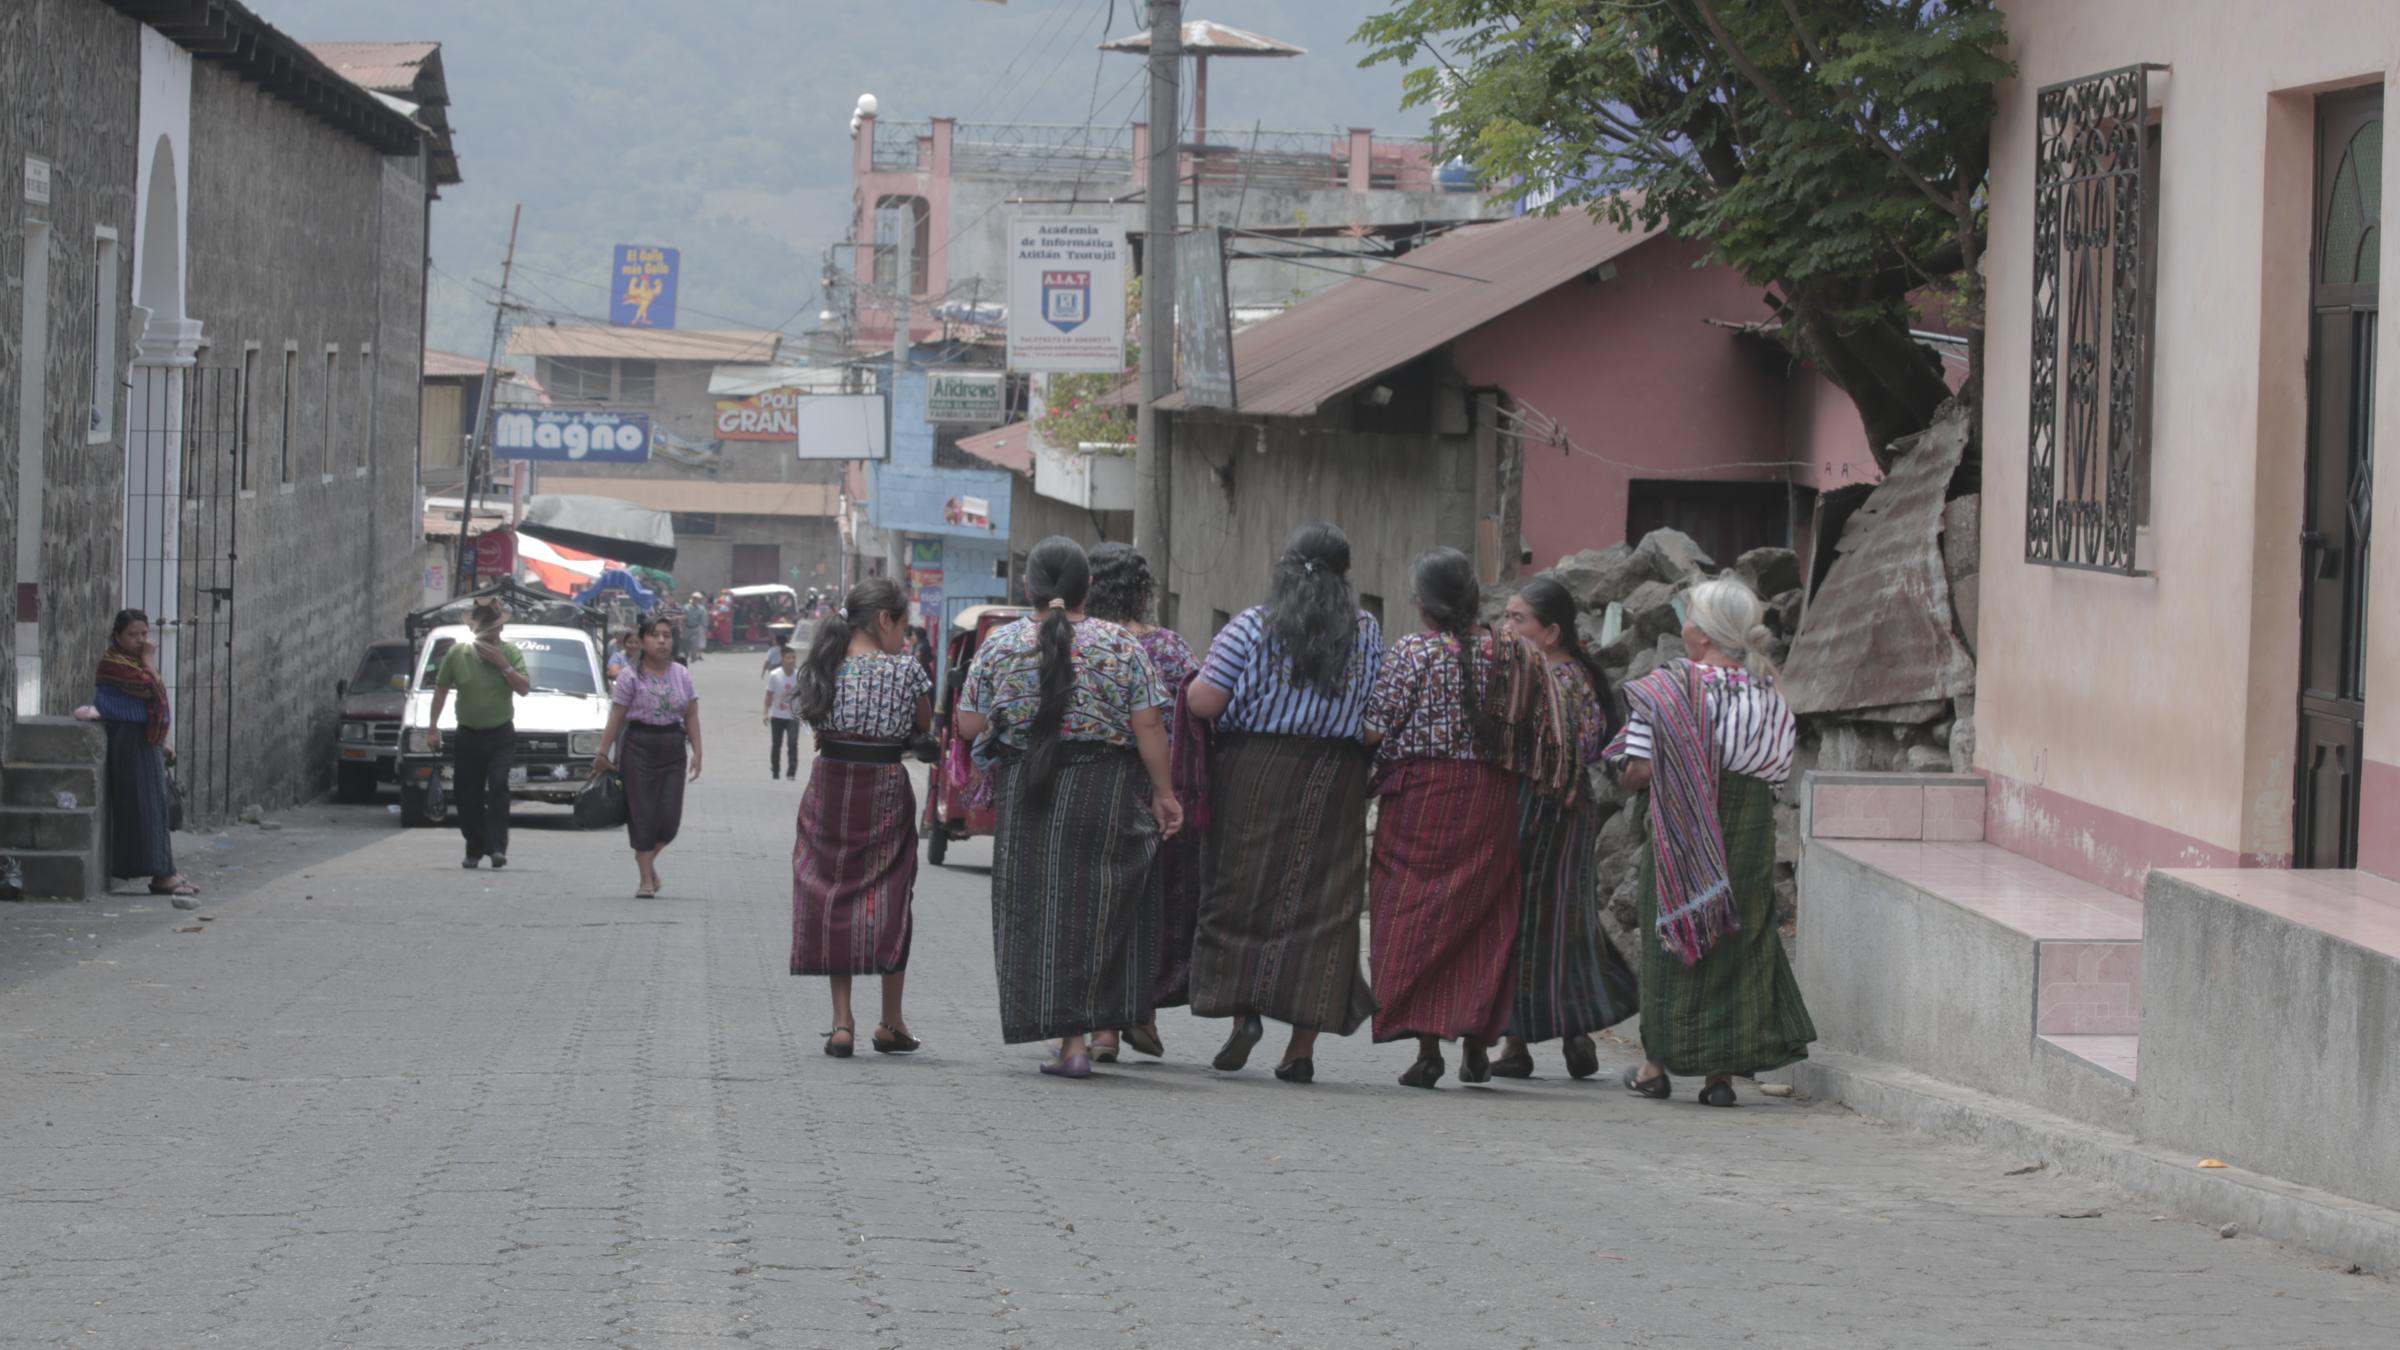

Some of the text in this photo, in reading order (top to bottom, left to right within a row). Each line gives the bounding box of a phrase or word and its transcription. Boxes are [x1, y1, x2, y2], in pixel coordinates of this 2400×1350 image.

[1038, 225, 1099, 235] Academia
[1021, 237, 1114, 248] de Informática
[1044, 274, 1089, 285] A.I.A.T.
[933, 377, 997, 398] Andrews
